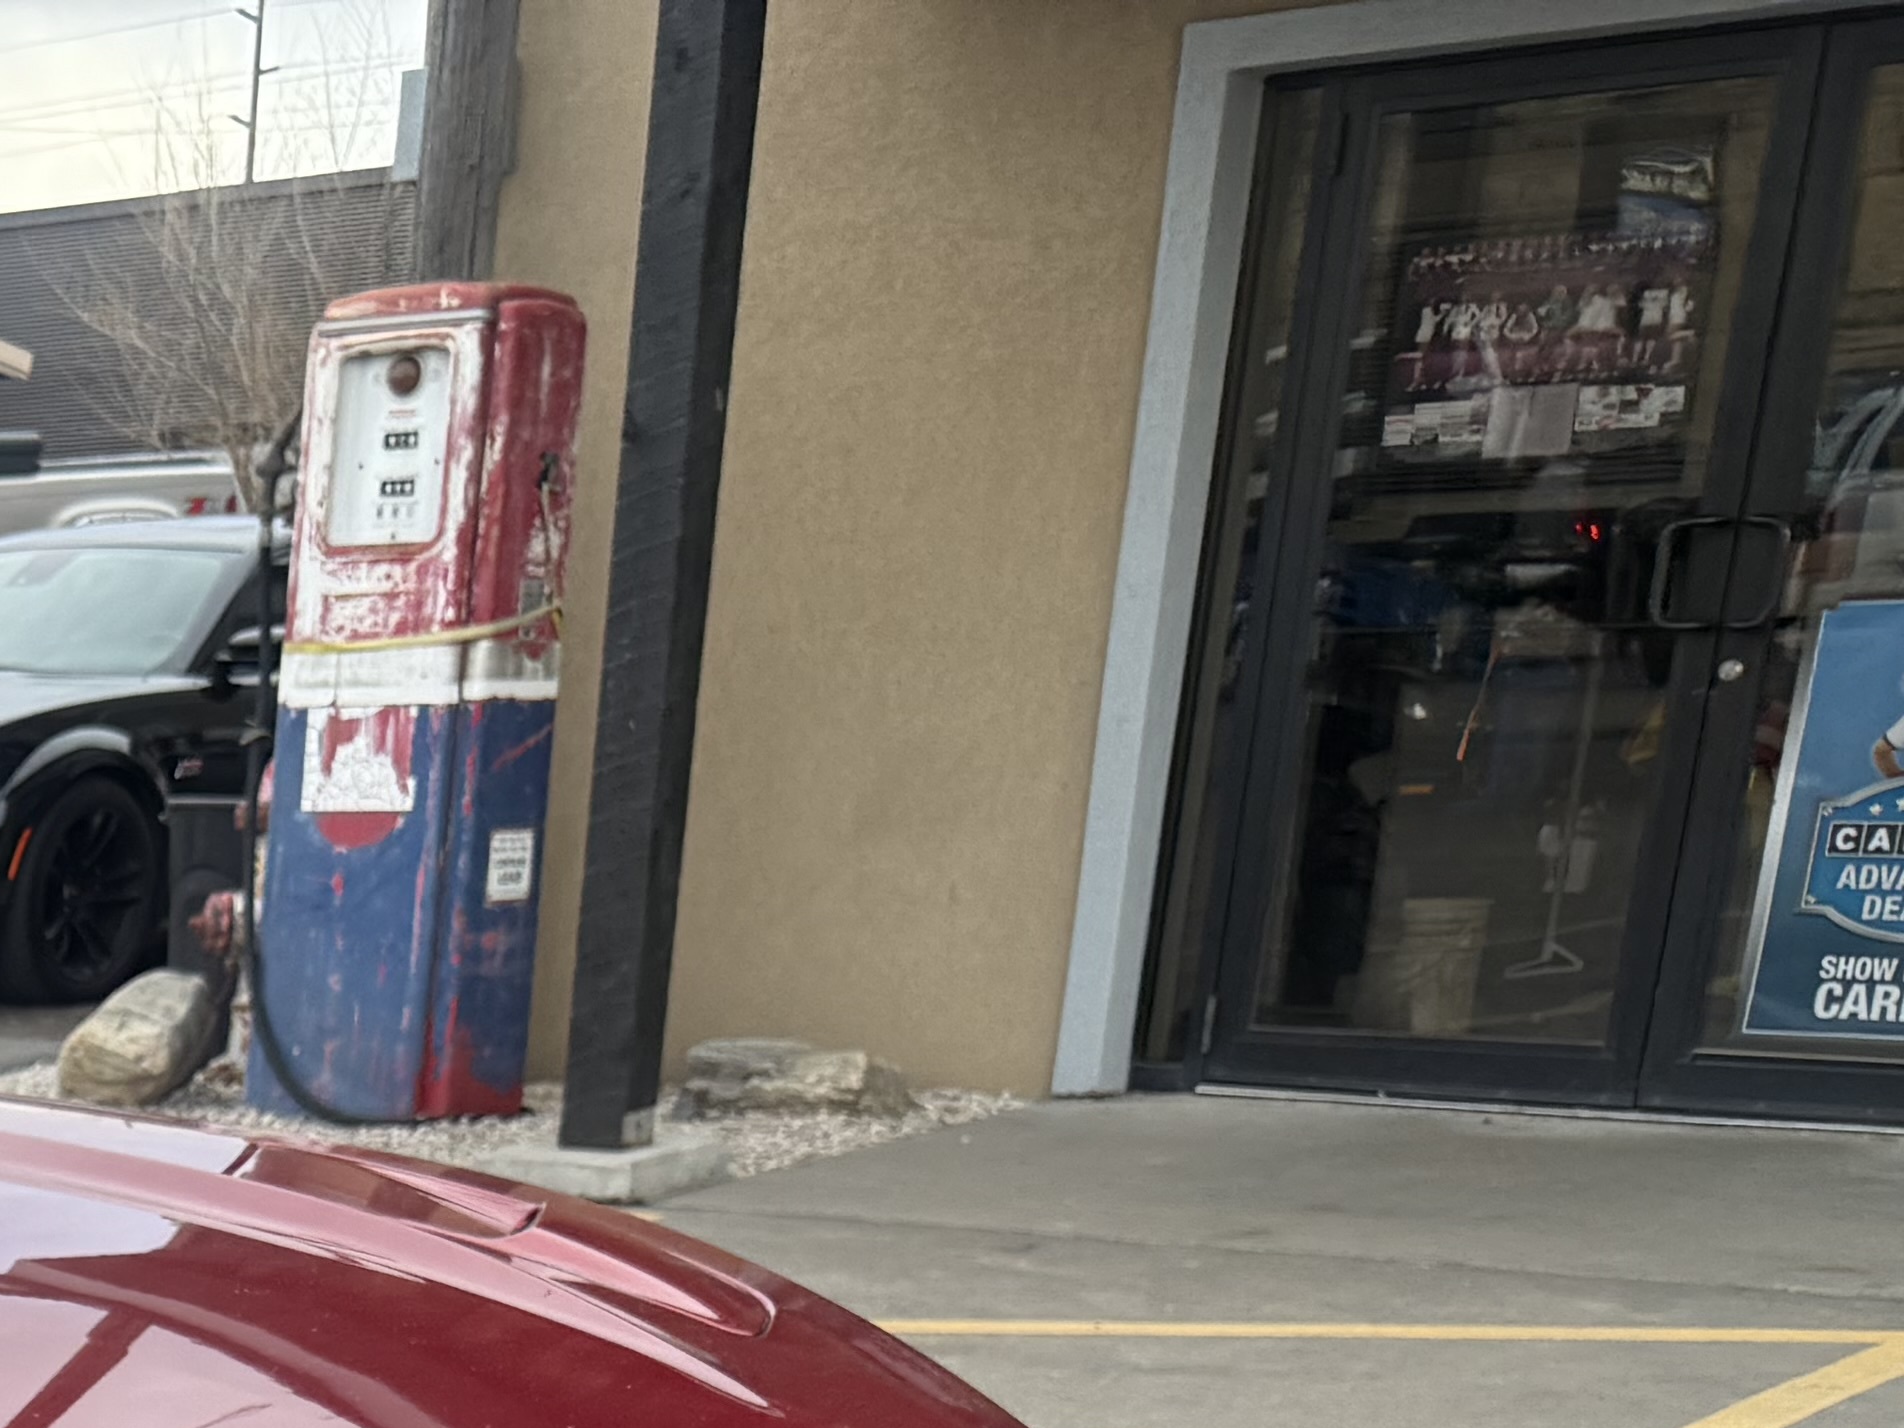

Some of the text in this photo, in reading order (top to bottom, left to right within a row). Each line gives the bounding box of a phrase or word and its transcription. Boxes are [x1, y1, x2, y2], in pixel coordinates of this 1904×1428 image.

[1835, 827, 1904, 852] CA
[1861, 895, 1904, 921] DE
[1819, 955, 1899, 981] SHOW
[1814, 982, 1904, 1022] CAR
